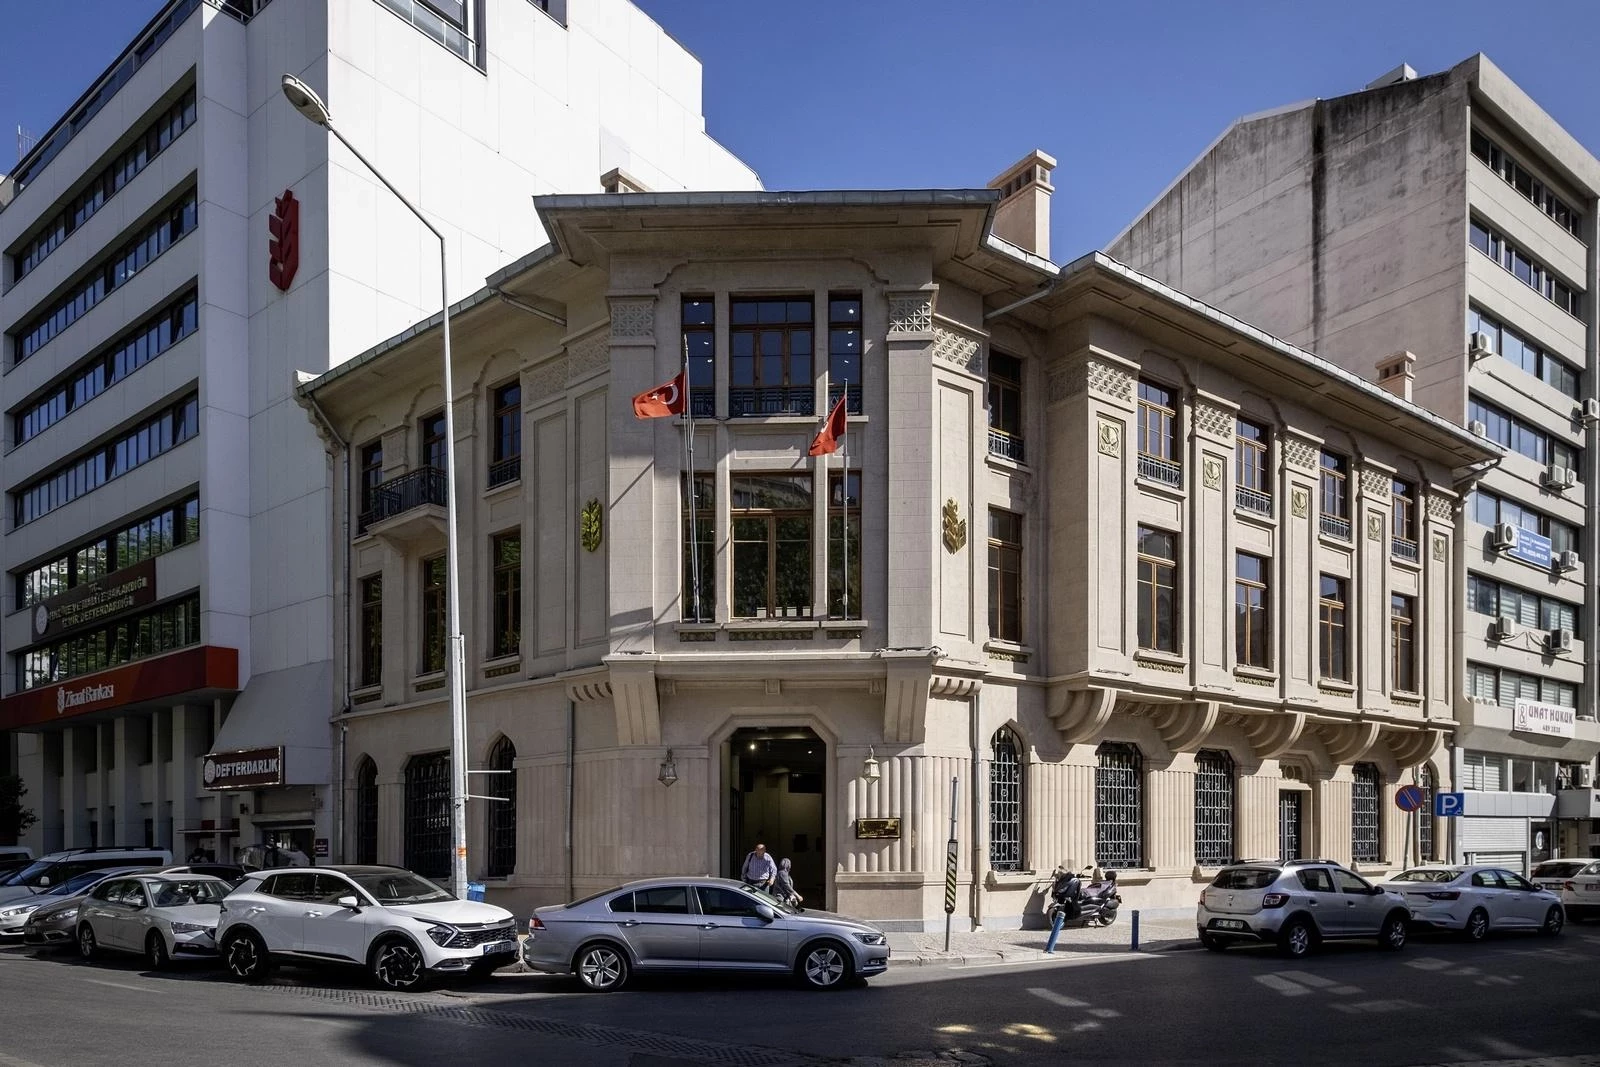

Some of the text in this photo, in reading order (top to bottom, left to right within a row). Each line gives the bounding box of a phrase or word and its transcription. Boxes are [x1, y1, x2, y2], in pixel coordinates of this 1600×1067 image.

[65, 684, 114, 707] Ziraat Bankası
[1549, 709, 1574, 724] HUKUK
[215, 758, 278, 778] DEFTERDARLIK
[1442, 795, 1458, 814] P
